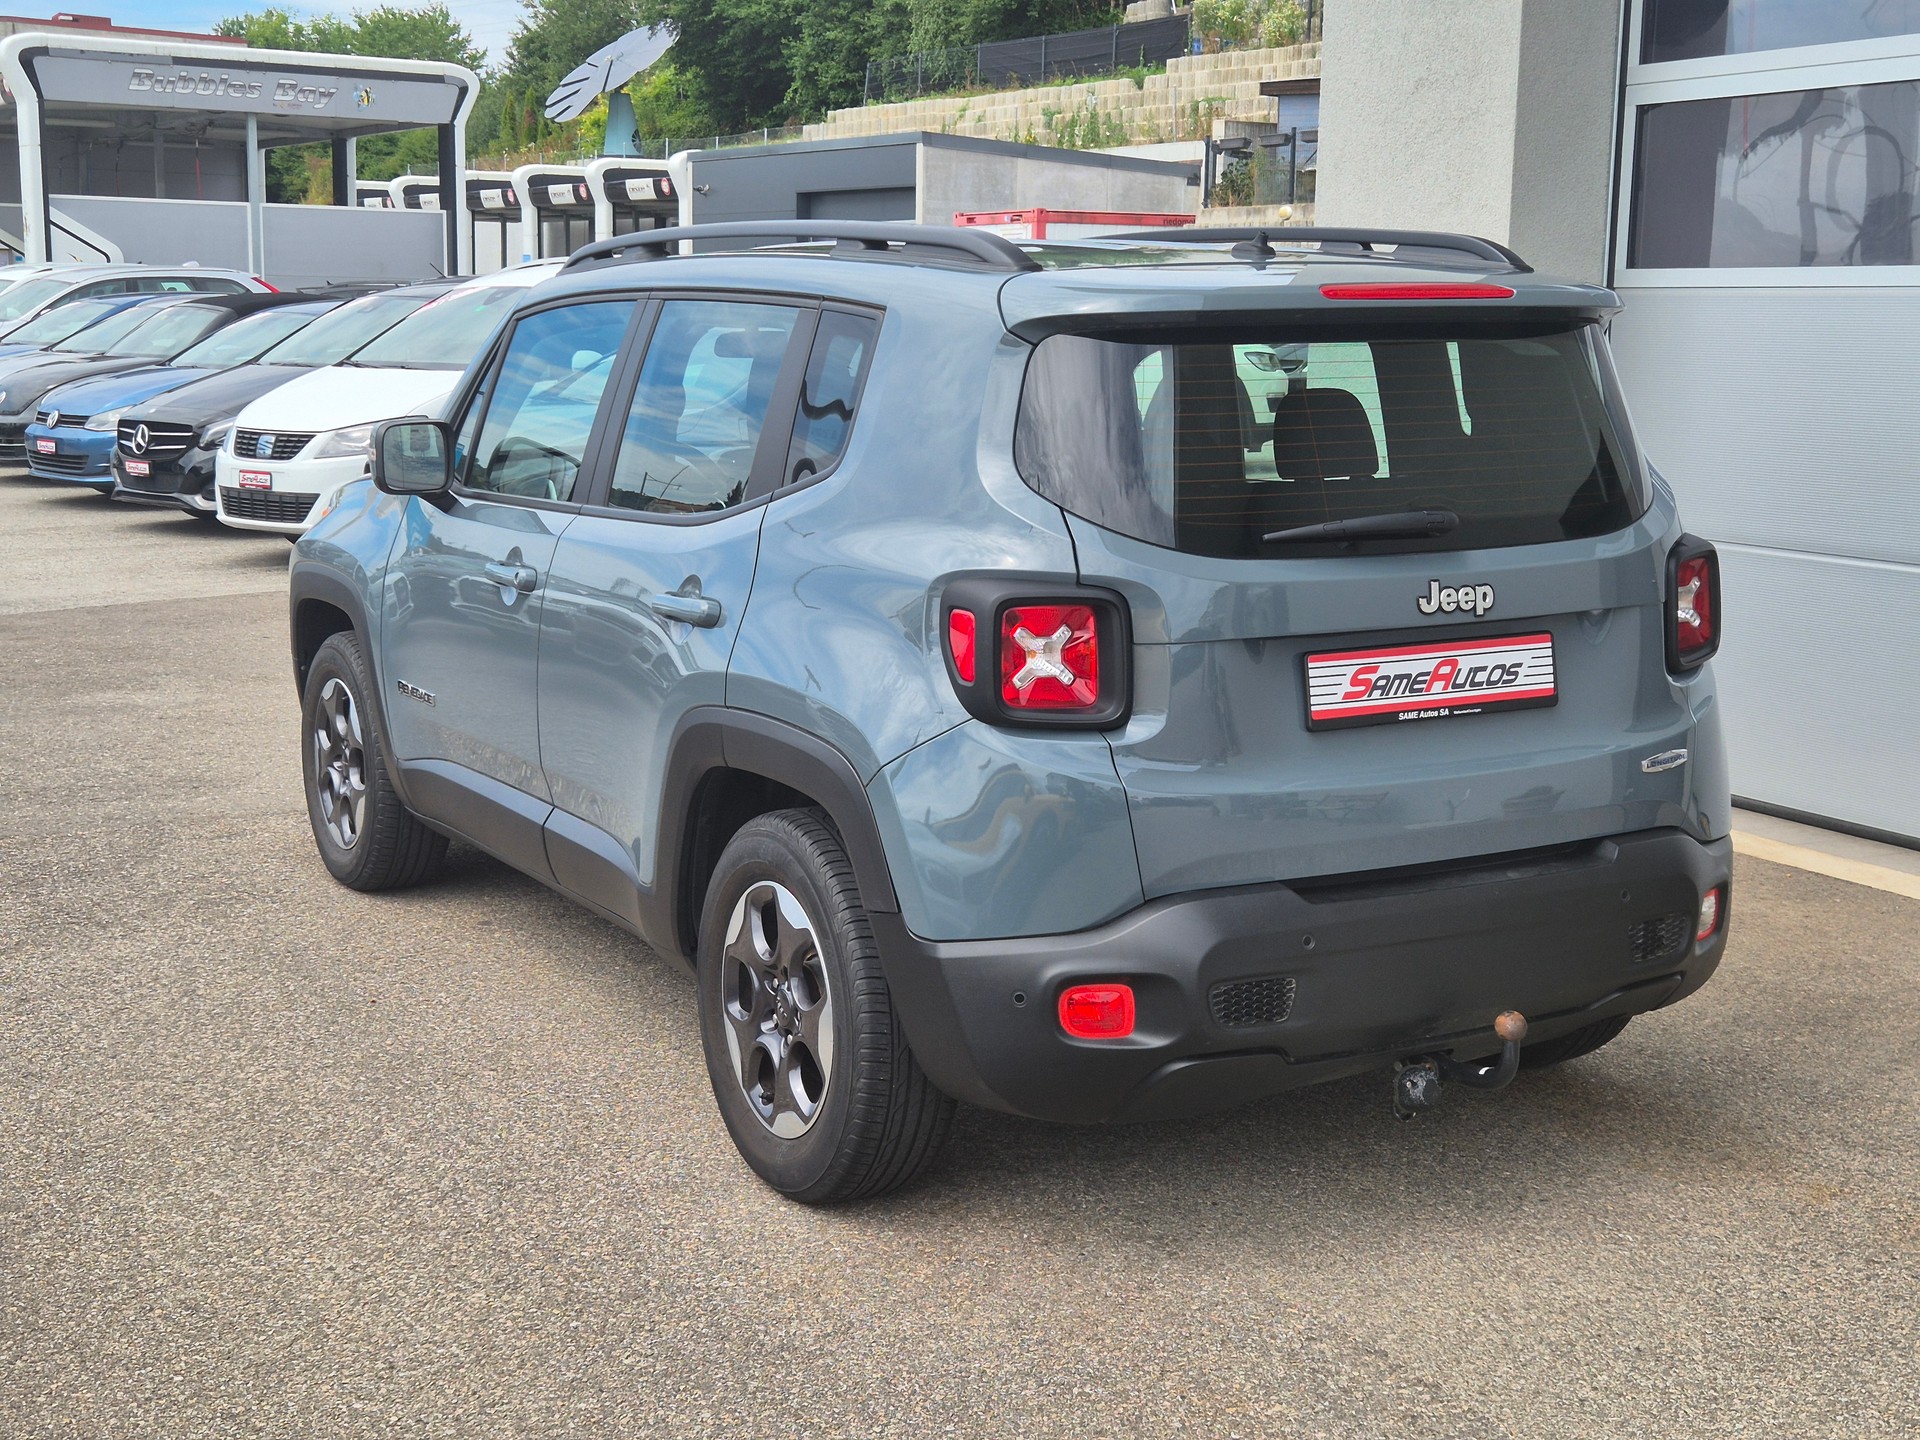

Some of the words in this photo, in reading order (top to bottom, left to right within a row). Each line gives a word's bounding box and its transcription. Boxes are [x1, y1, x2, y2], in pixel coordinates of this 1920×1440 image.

[128, 68, 263, 98] Bubbles
[272, 78, 339, 109] Bay
[1417, 579, 1495, 617] Jeep
[1398, 710, 1418, 720] SAME
[1419, 709, 1438, 718] Autos
[1439, 708, 1449, 716] SA
